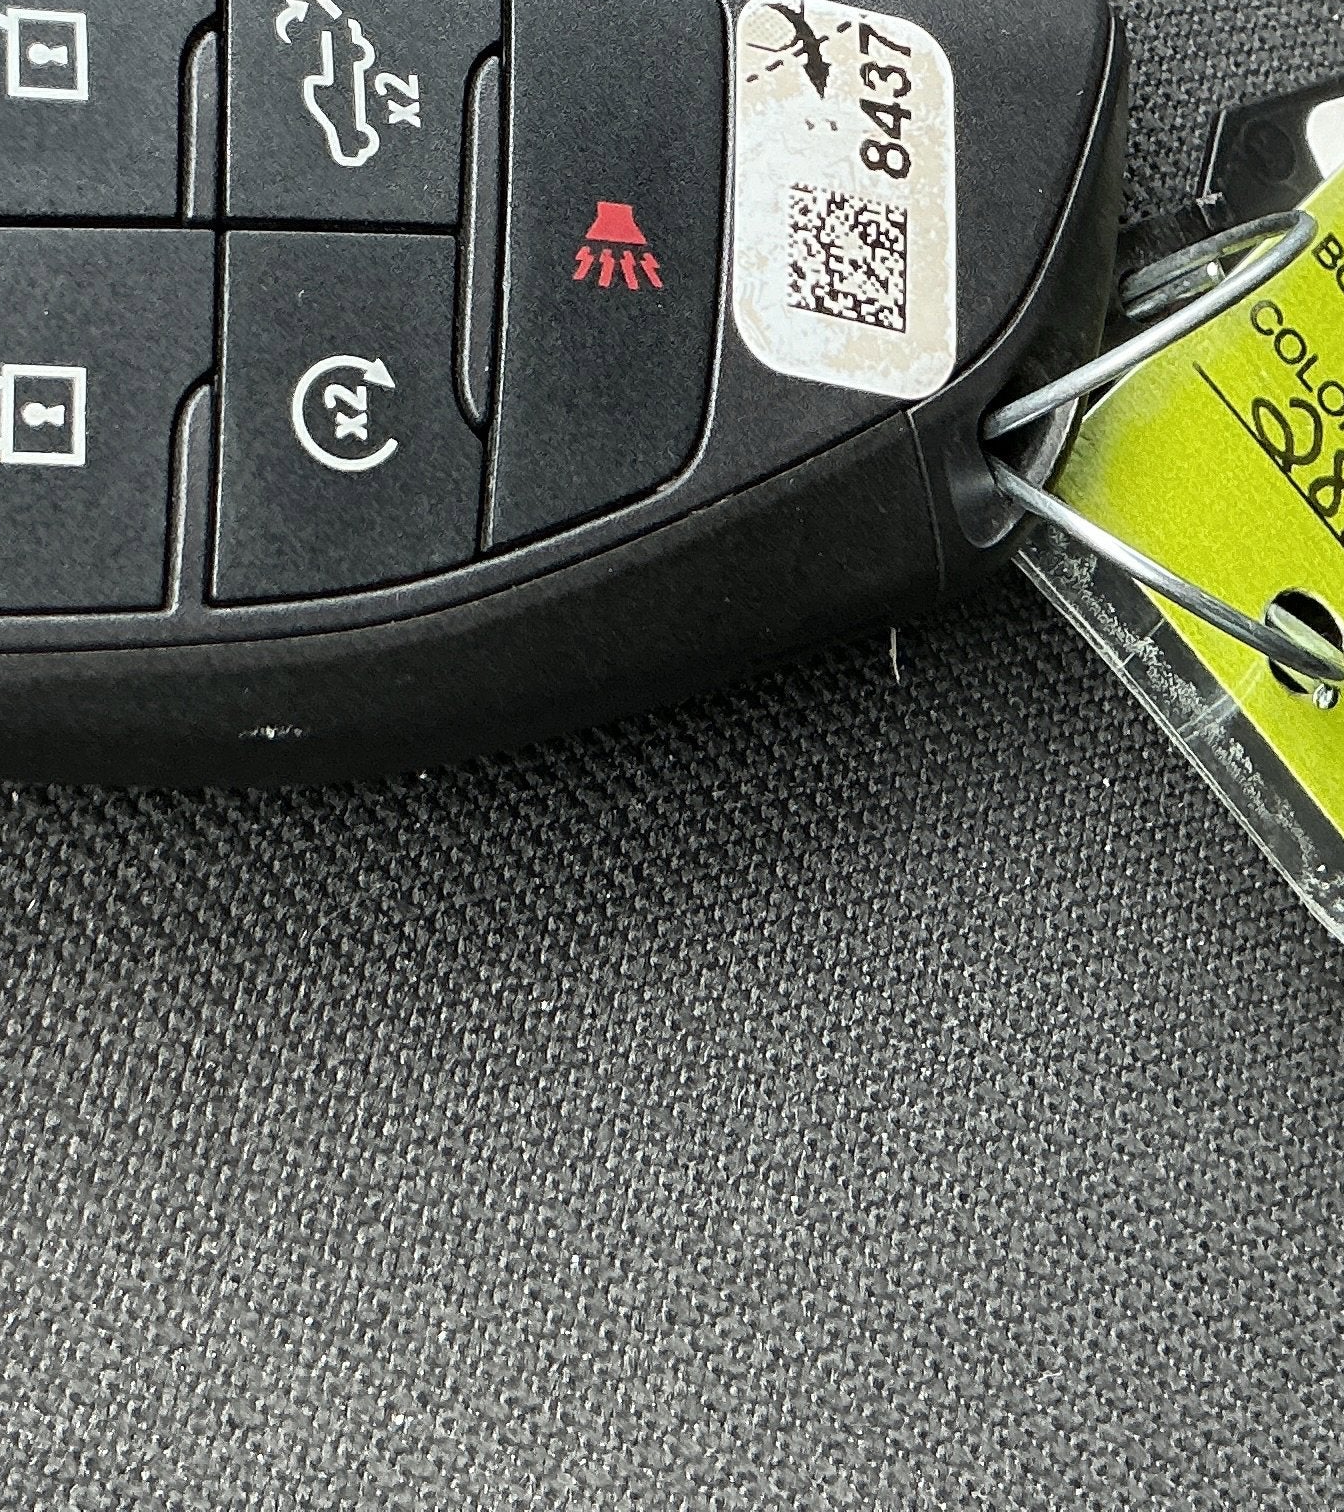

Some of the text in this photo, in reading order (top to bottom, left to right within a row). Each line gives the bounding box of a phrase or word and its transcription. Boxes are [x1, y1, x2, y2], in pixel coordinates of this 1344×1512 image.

[375, 73, 420, 128] x2
[859, 25, 913, 181] 8437
[323, 384, 369, 442] x2
